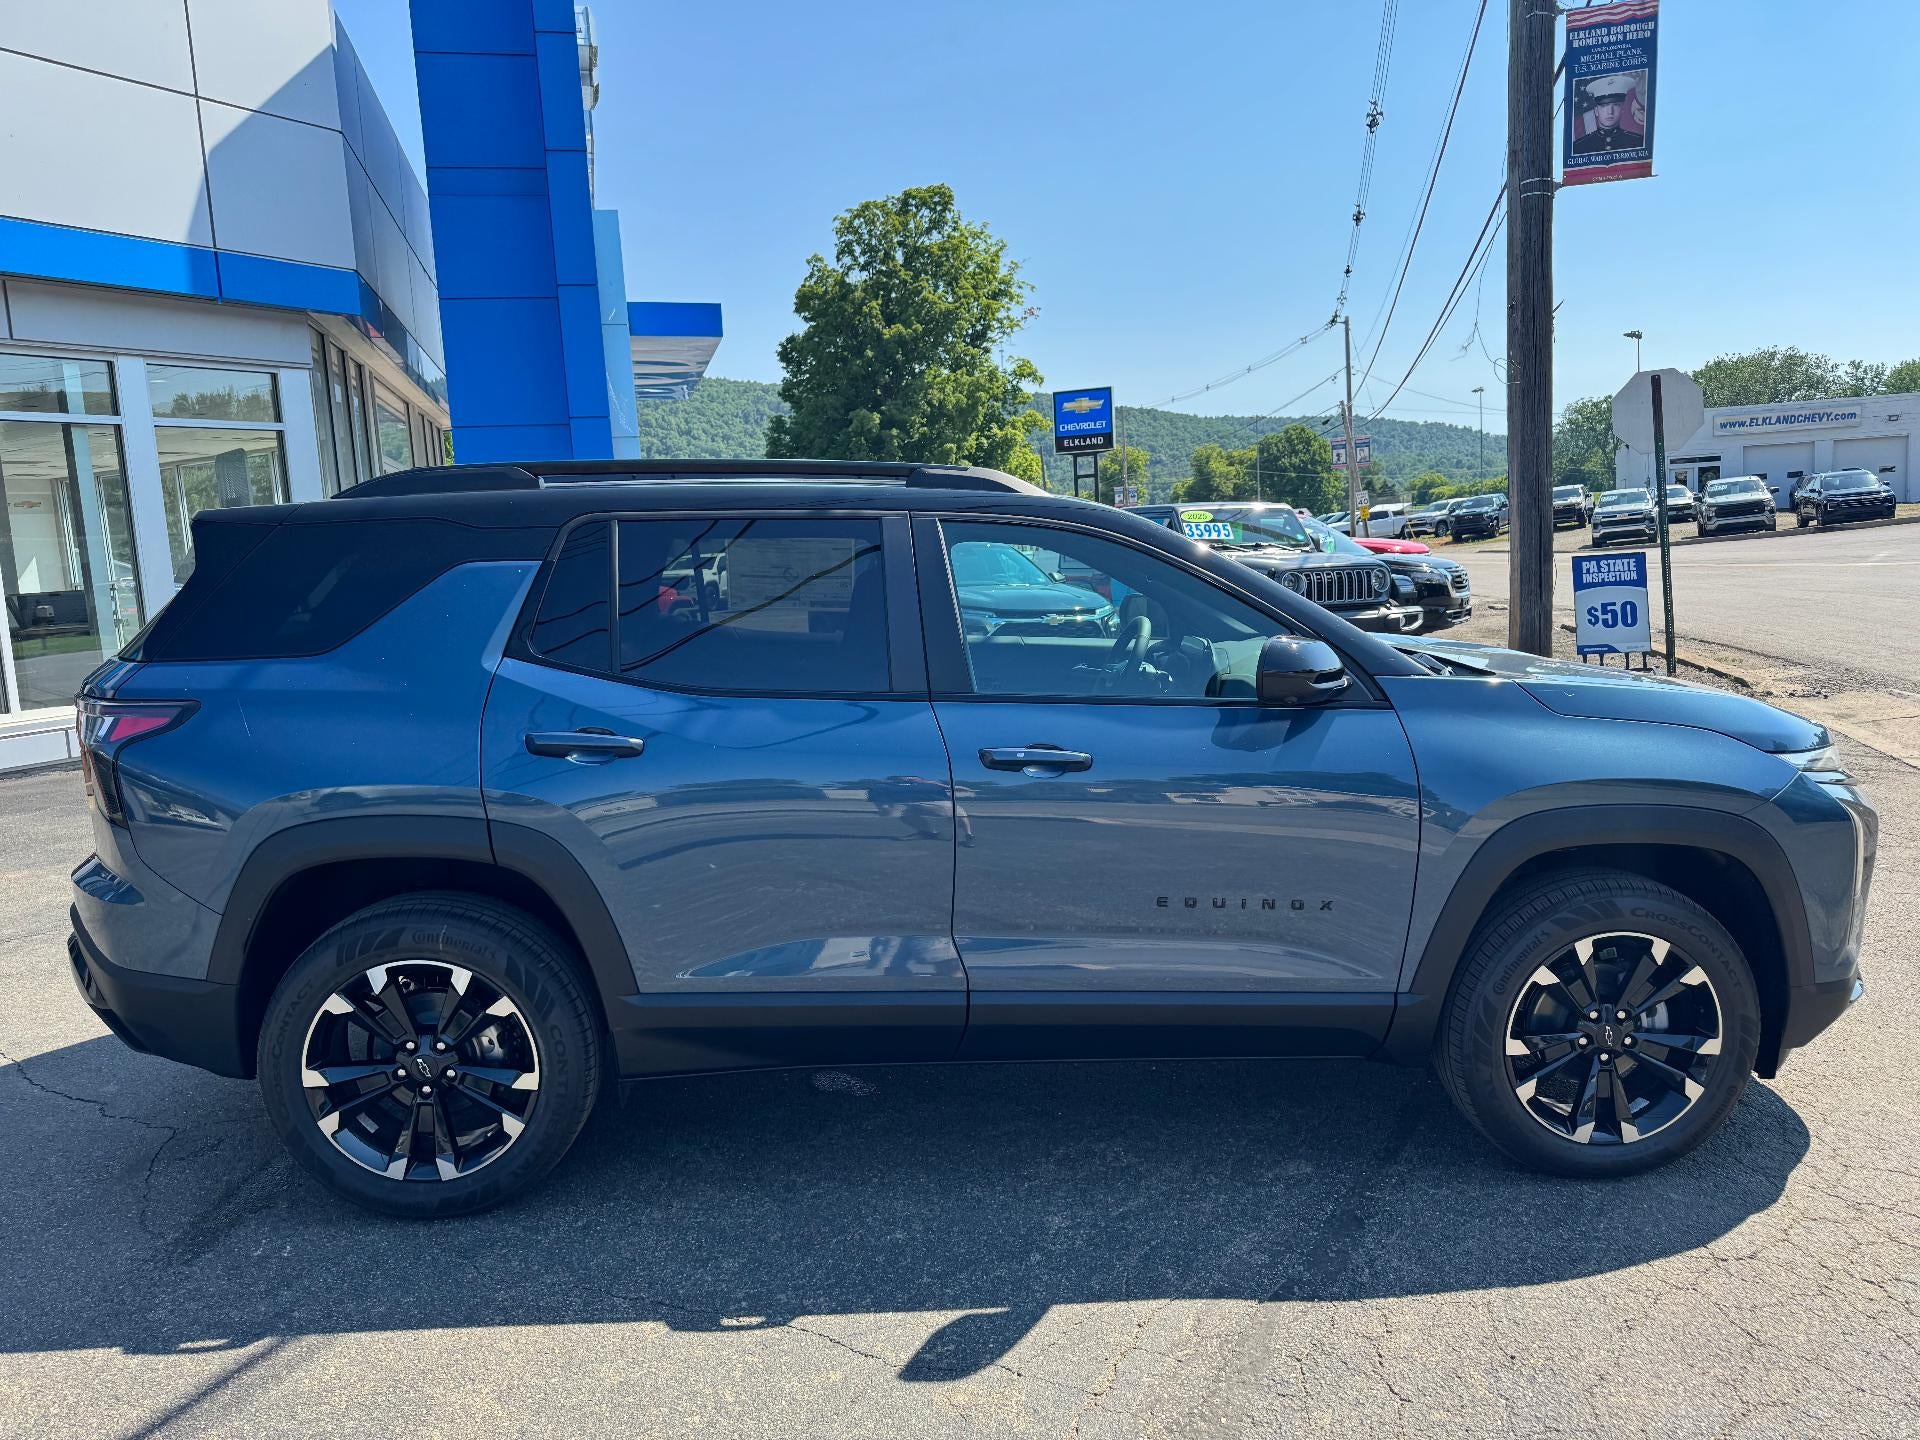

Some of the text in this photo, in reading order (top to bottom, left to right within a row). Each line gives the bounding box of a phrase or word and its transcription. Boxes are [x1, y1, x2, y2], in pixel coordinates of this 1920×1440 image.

[1569, 21, 1655, 40] ELKLAND BOROUGH
[1572, 30, 1651, 47] HOMETOWN HERO
[1580, 52, 1615, 63] MICHAEL
[1590, 60, 1620, 71] MARINE
[1622, 56, 1648, 66] CORPS
[1059, 420, 1107, 432] CHEVROLET
[1719, 411, 1857, 430] www.ELKLANDCHEVY.com
[1064, 436, 1104, 447] ELKLAND
[1185, 523, 1231, 538] 35995
[1582, 558, 1637, 574] PA STATE
[1582, 570, 1638, 583] INSPECTION
[1586, 600, 1638, 629] $50
[1156, 896, 1333, 911] EQUINOX
